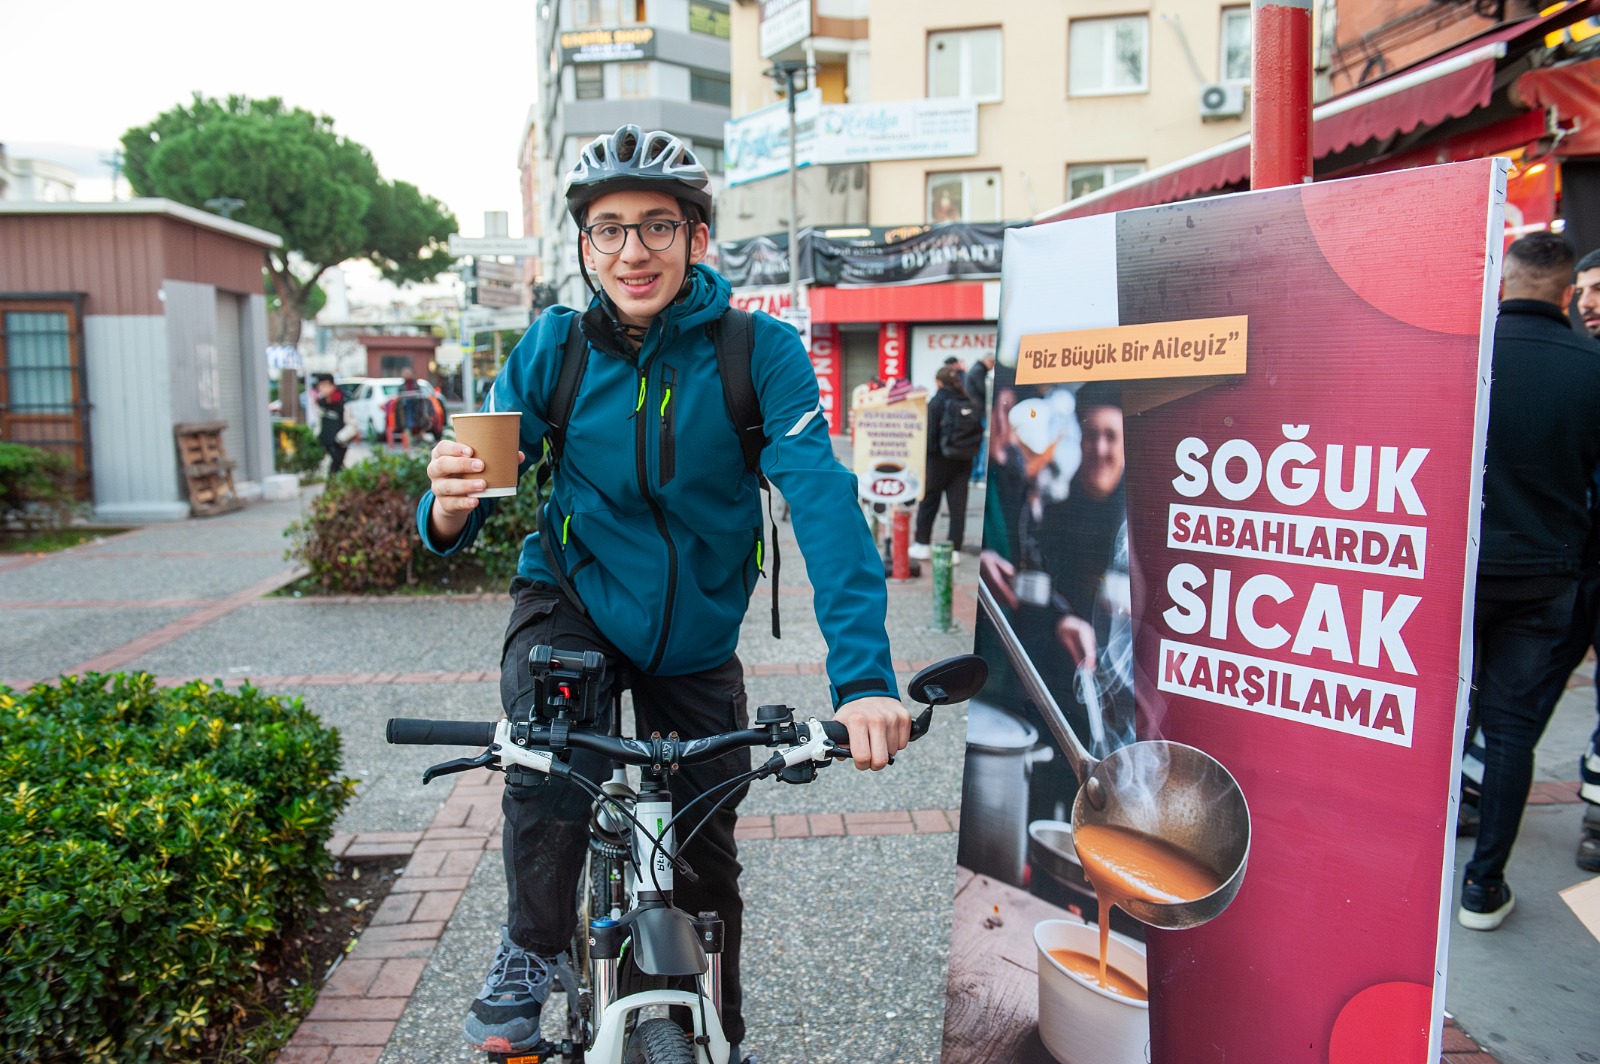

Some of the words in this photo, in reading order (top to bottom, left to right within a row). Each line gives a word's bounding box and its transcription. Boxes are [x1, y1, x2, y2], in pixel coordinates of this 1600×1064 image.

[1061, 343, 1117, 370] Büyük
[1121, 340, 1149, 362] Bir
[1172, 424, 1431, 516] SOĞUK
[1172, 512, 1418, 571] SABAHLARDA
[1162, 562, 1423, 676] SICAK
[1164, 649, 1406, 736] KARŞILAMA
